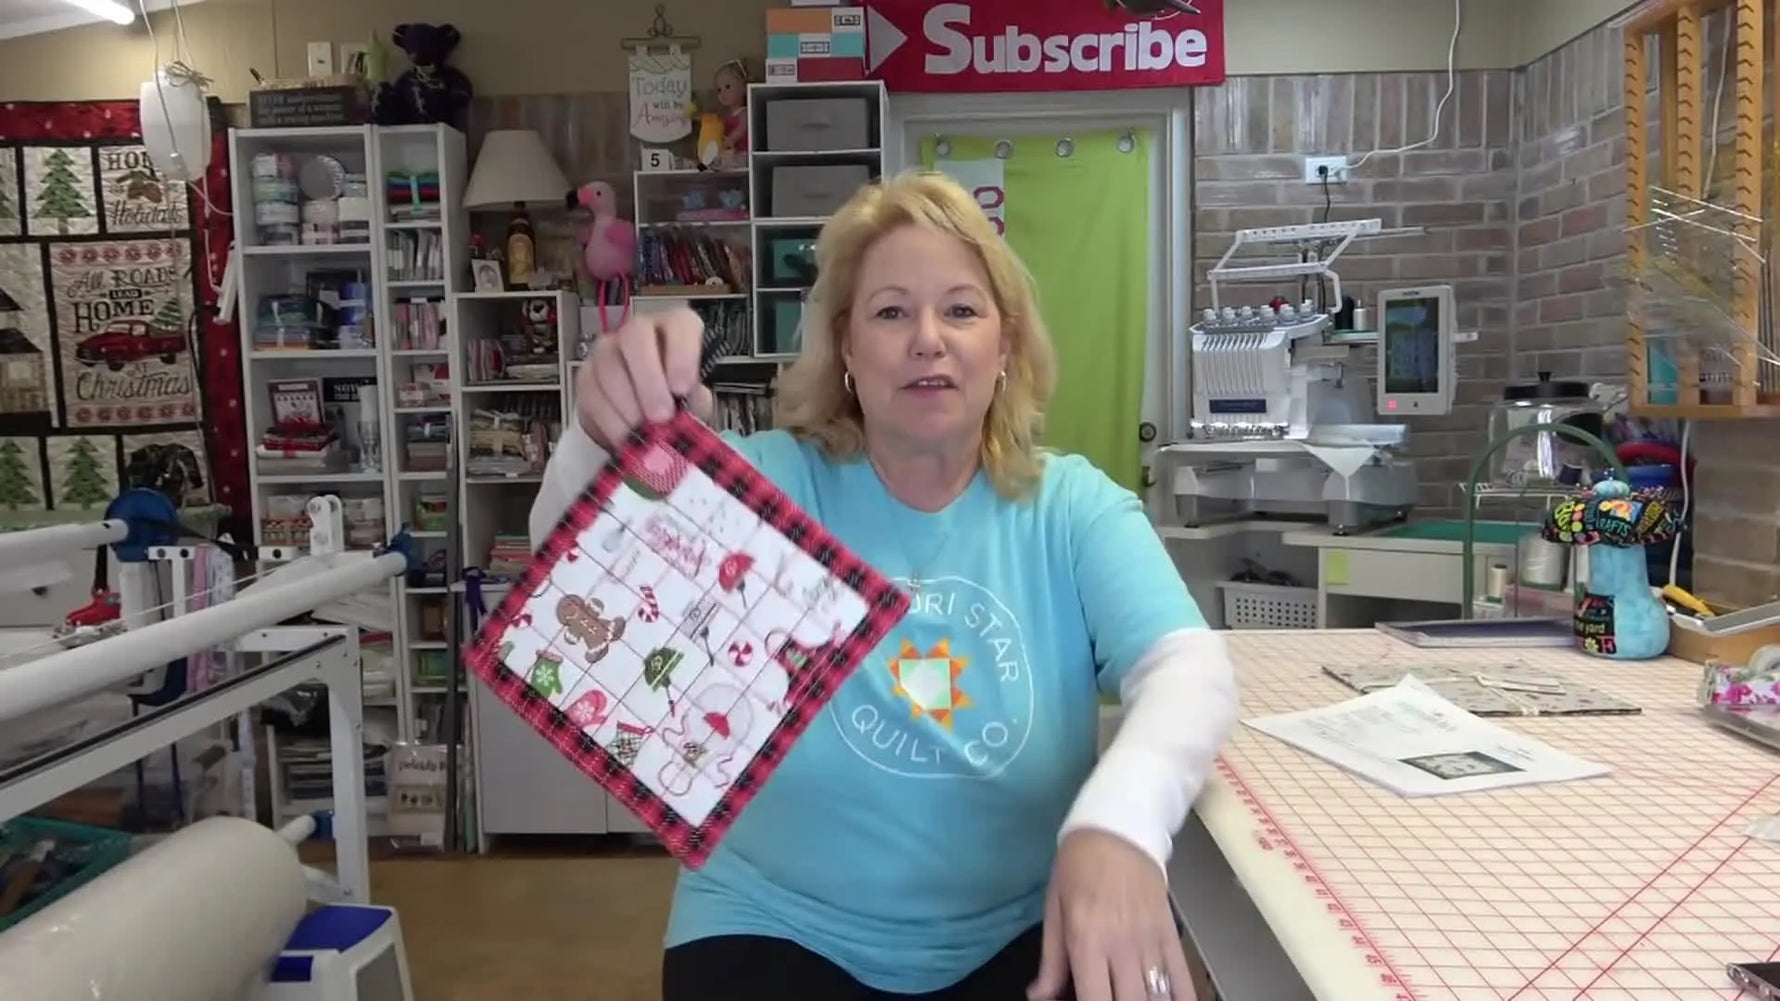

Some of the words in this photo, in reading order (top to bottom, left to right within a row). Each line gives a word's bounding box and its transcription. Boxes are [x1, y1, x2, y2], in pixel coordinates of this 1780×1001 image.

[923, 3, 1207, 75] Subscribe
[632, 76, 687, 99] Today
[653, 102, 671, 110] will
[650, 153, 660, 167] 5
[67, 271, 105, 298] All
[111, 265, 175, 288] ROADS
[72, 299, 155, 335] HOME
[77, 371, 190, 401] Christmas
[964, 602, 1020, 683] STAR
[851, 704, 944, 764] QUILT
